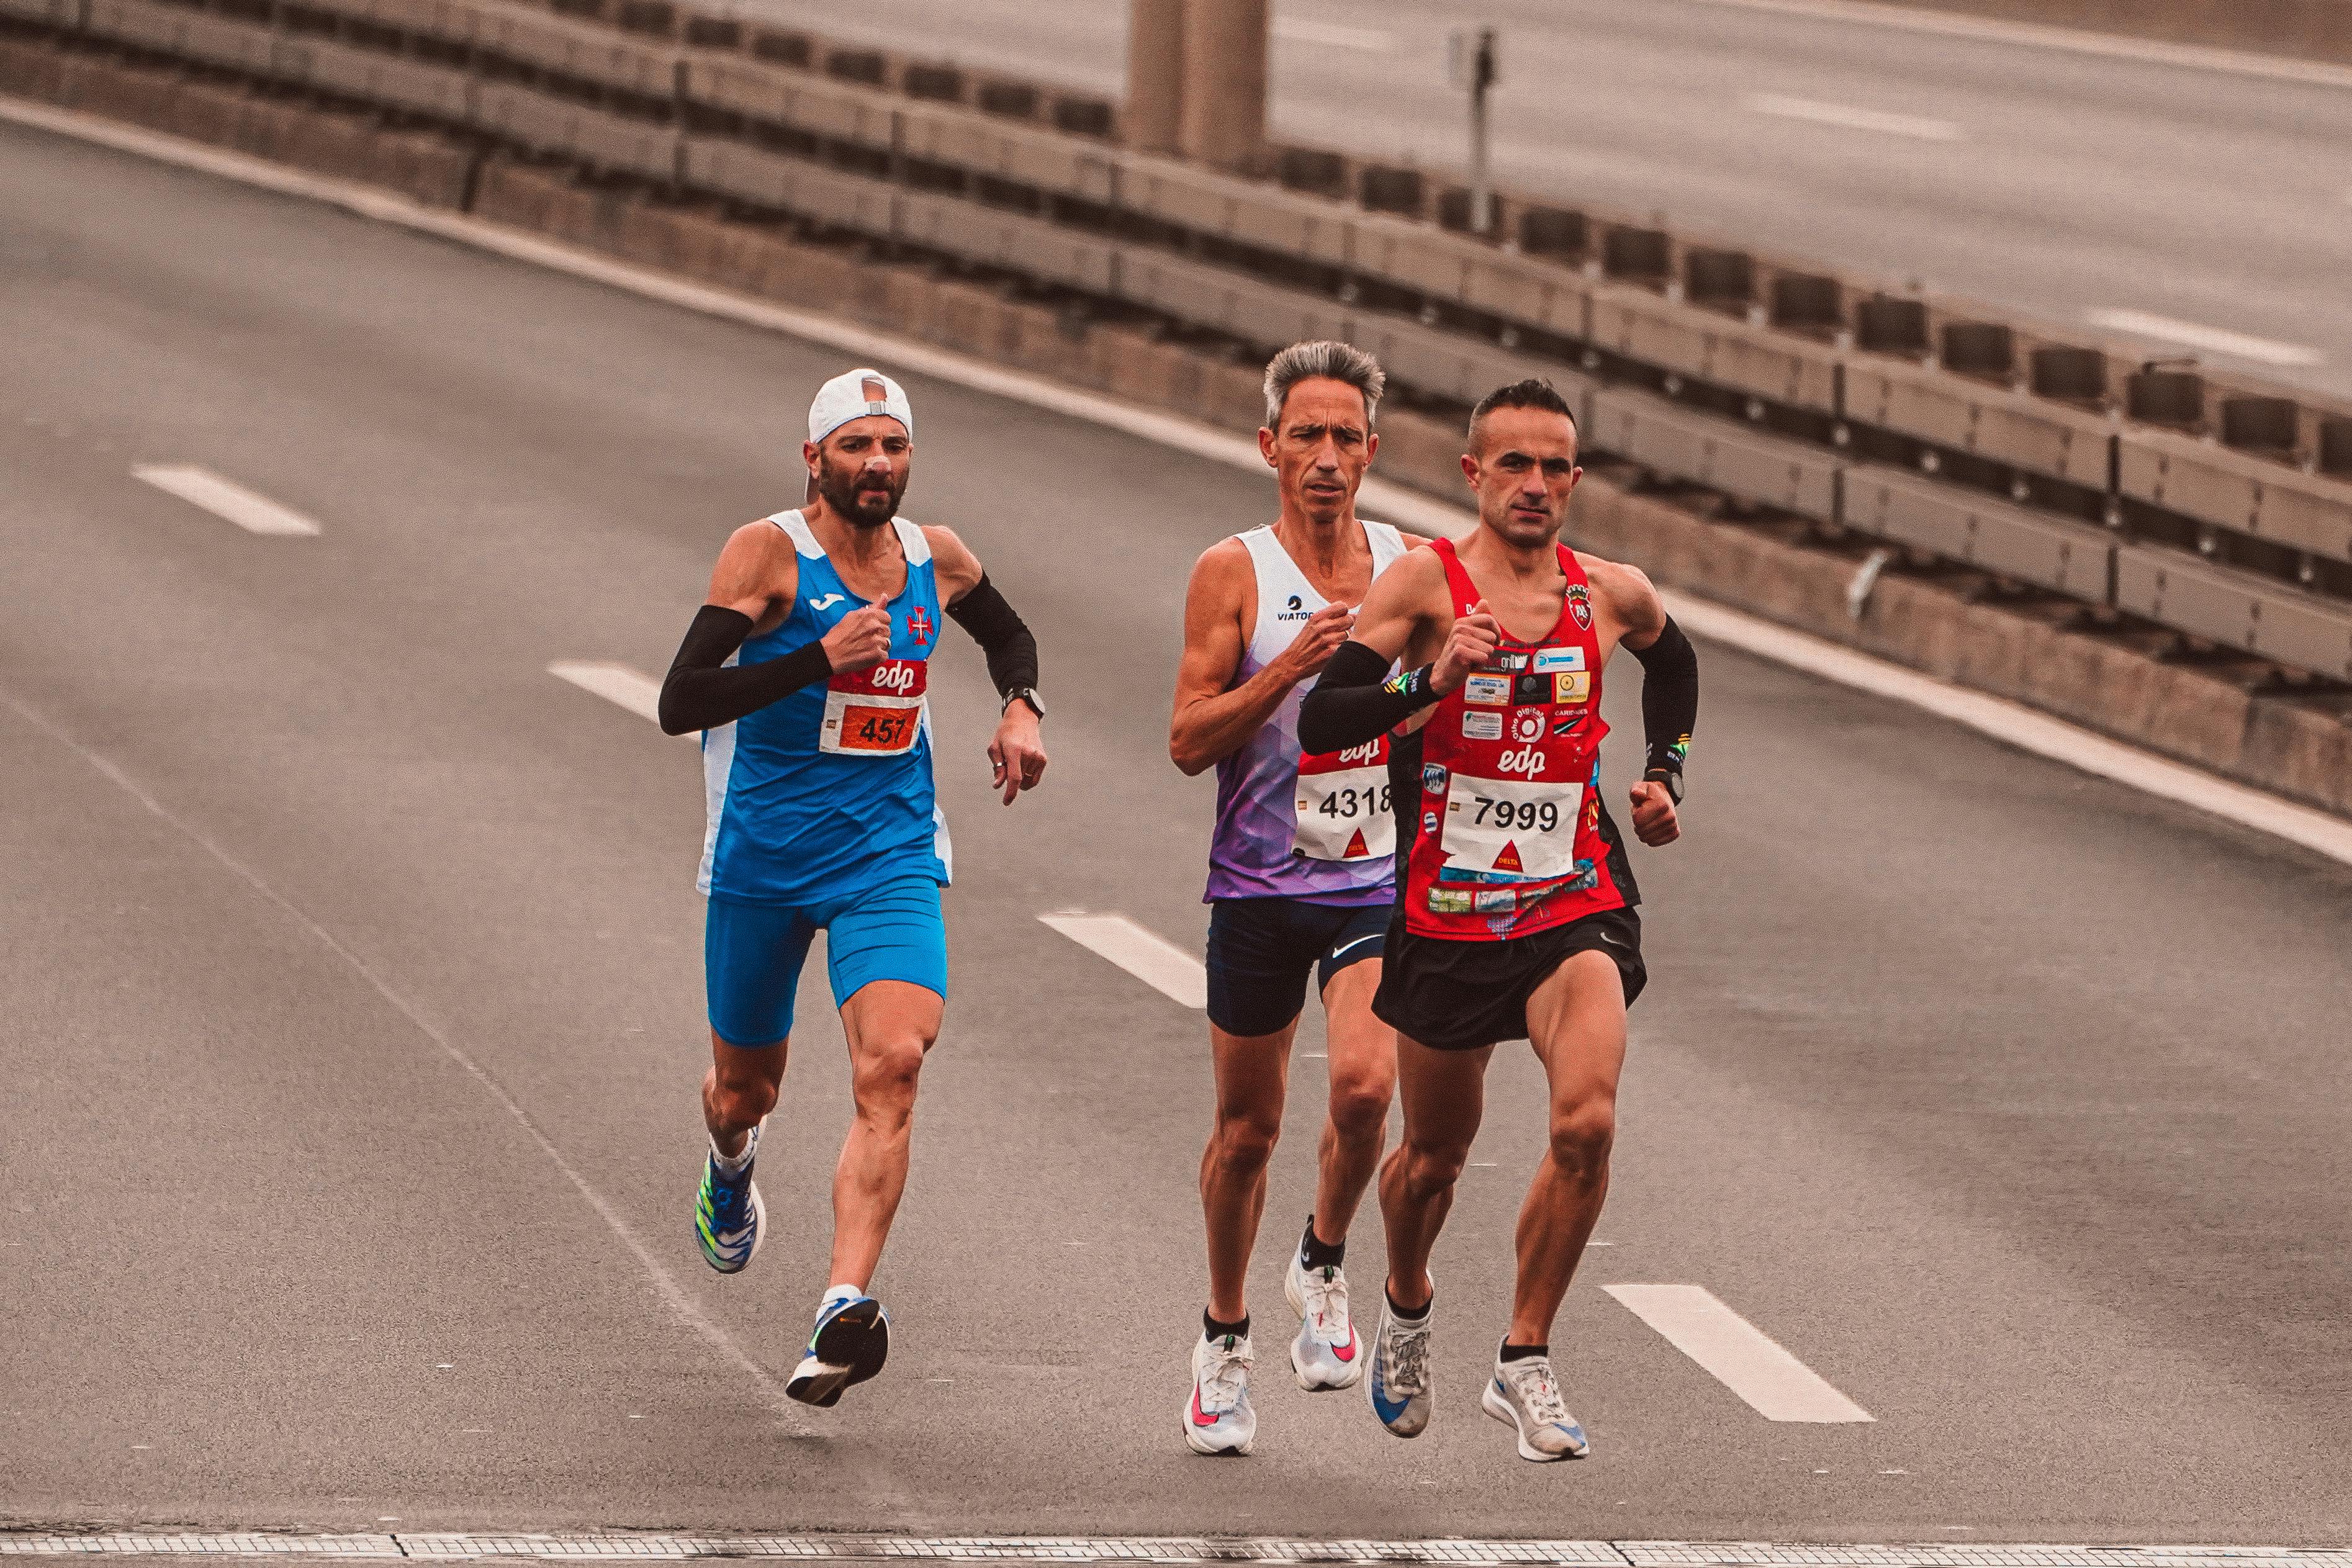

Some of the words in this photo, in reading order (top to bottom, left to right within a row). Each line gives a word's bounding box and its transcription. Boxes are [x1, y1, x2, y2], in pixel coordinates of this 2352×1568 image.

[872, 661, 914, 695] edp
[859, 716, 907, 744] 457
[1497, 744, 1546, 781] edp
[1319, 784, 1391, 819] 4318
[1475, 796, 1558, 832] 7999
[1498, 857, 1518, 866] DELTA
